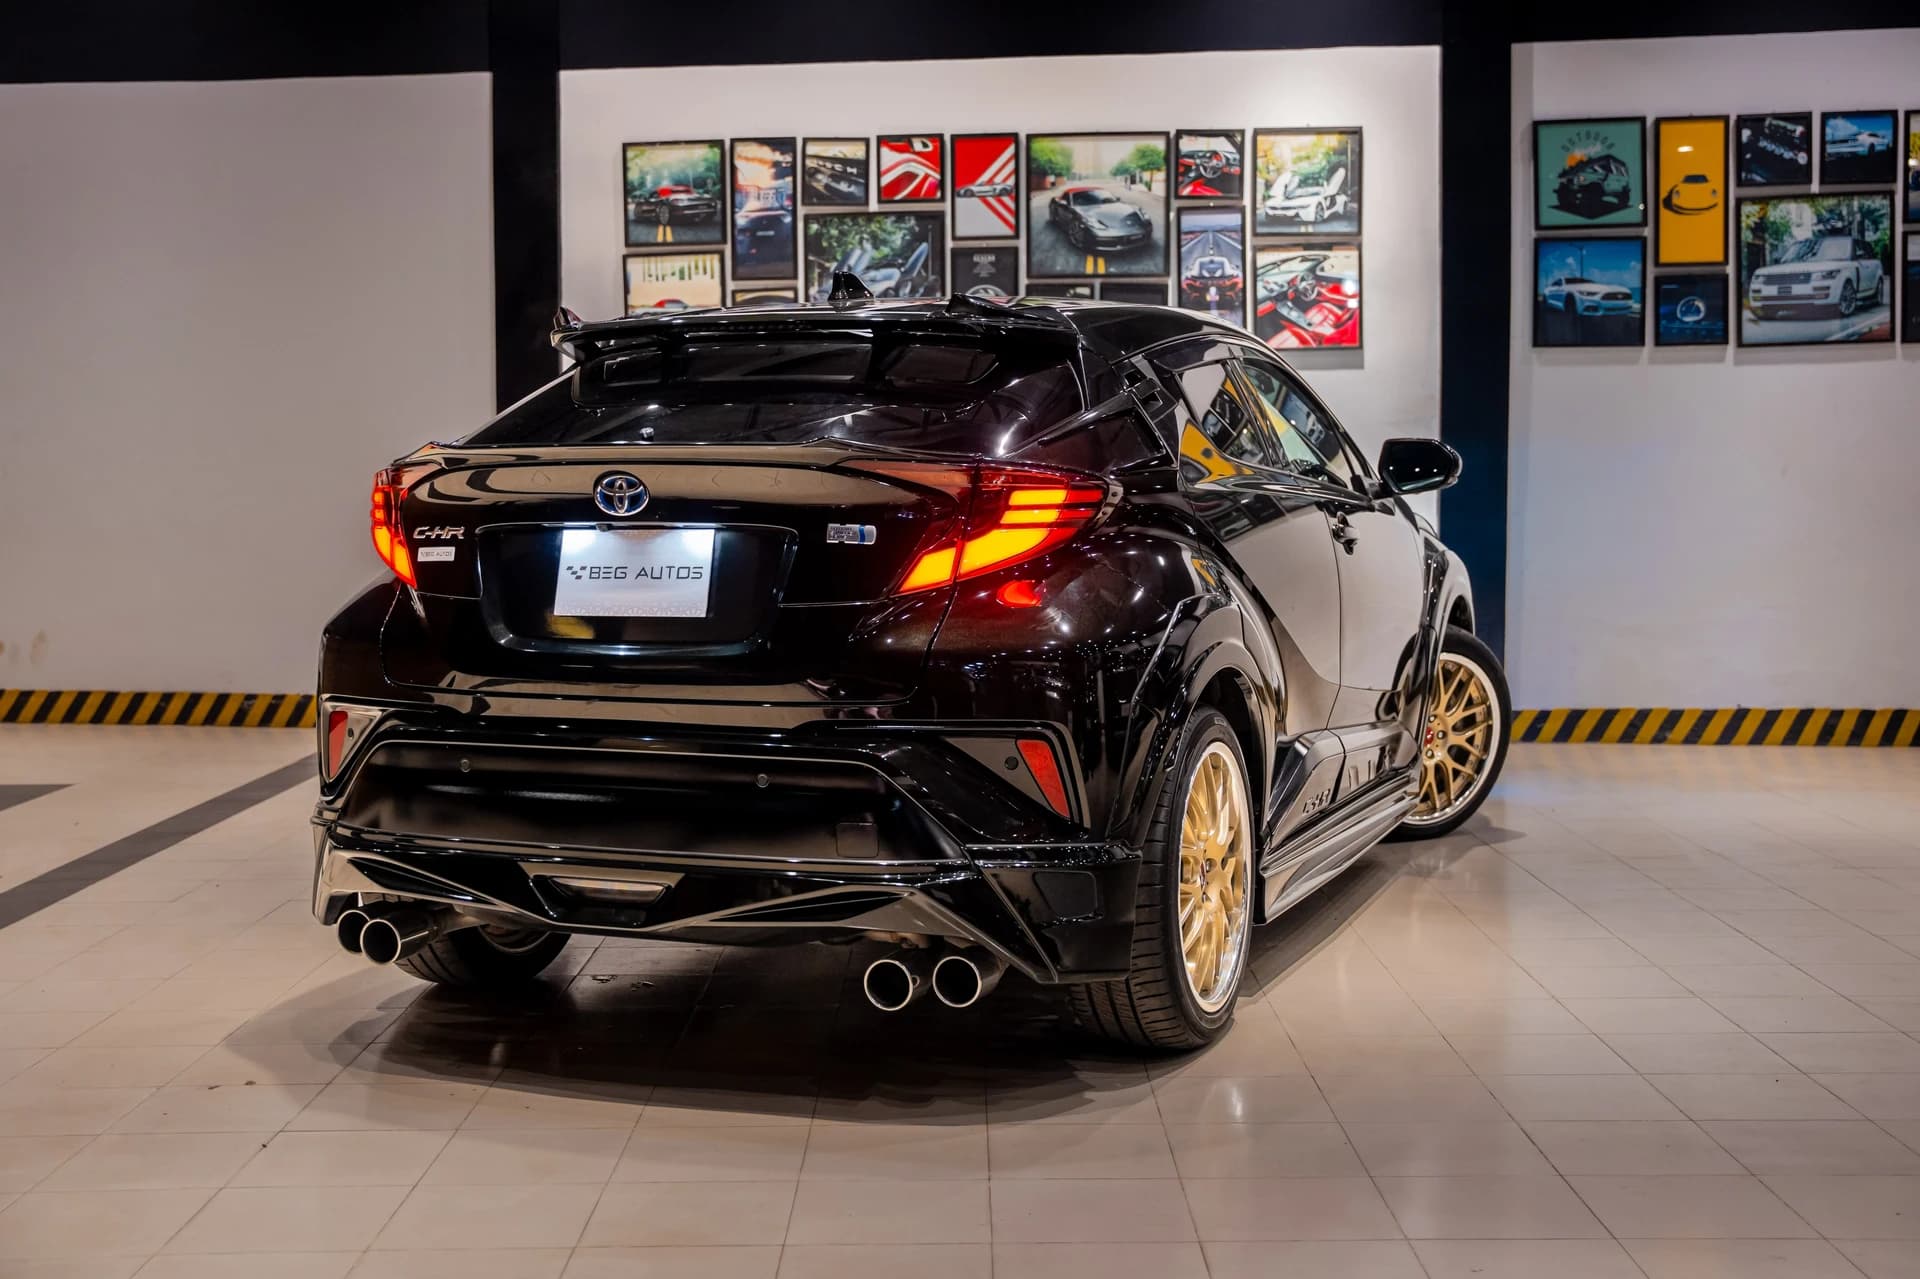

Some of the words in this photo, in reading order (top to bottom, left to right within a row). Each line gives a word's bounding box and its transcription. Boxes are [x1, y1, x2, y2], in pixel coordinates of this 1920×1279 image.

[413, 526, 465, 539] C-HR
[589, 566, 628, 580] BEG
[635, 566, 704, 580] AUTOS
